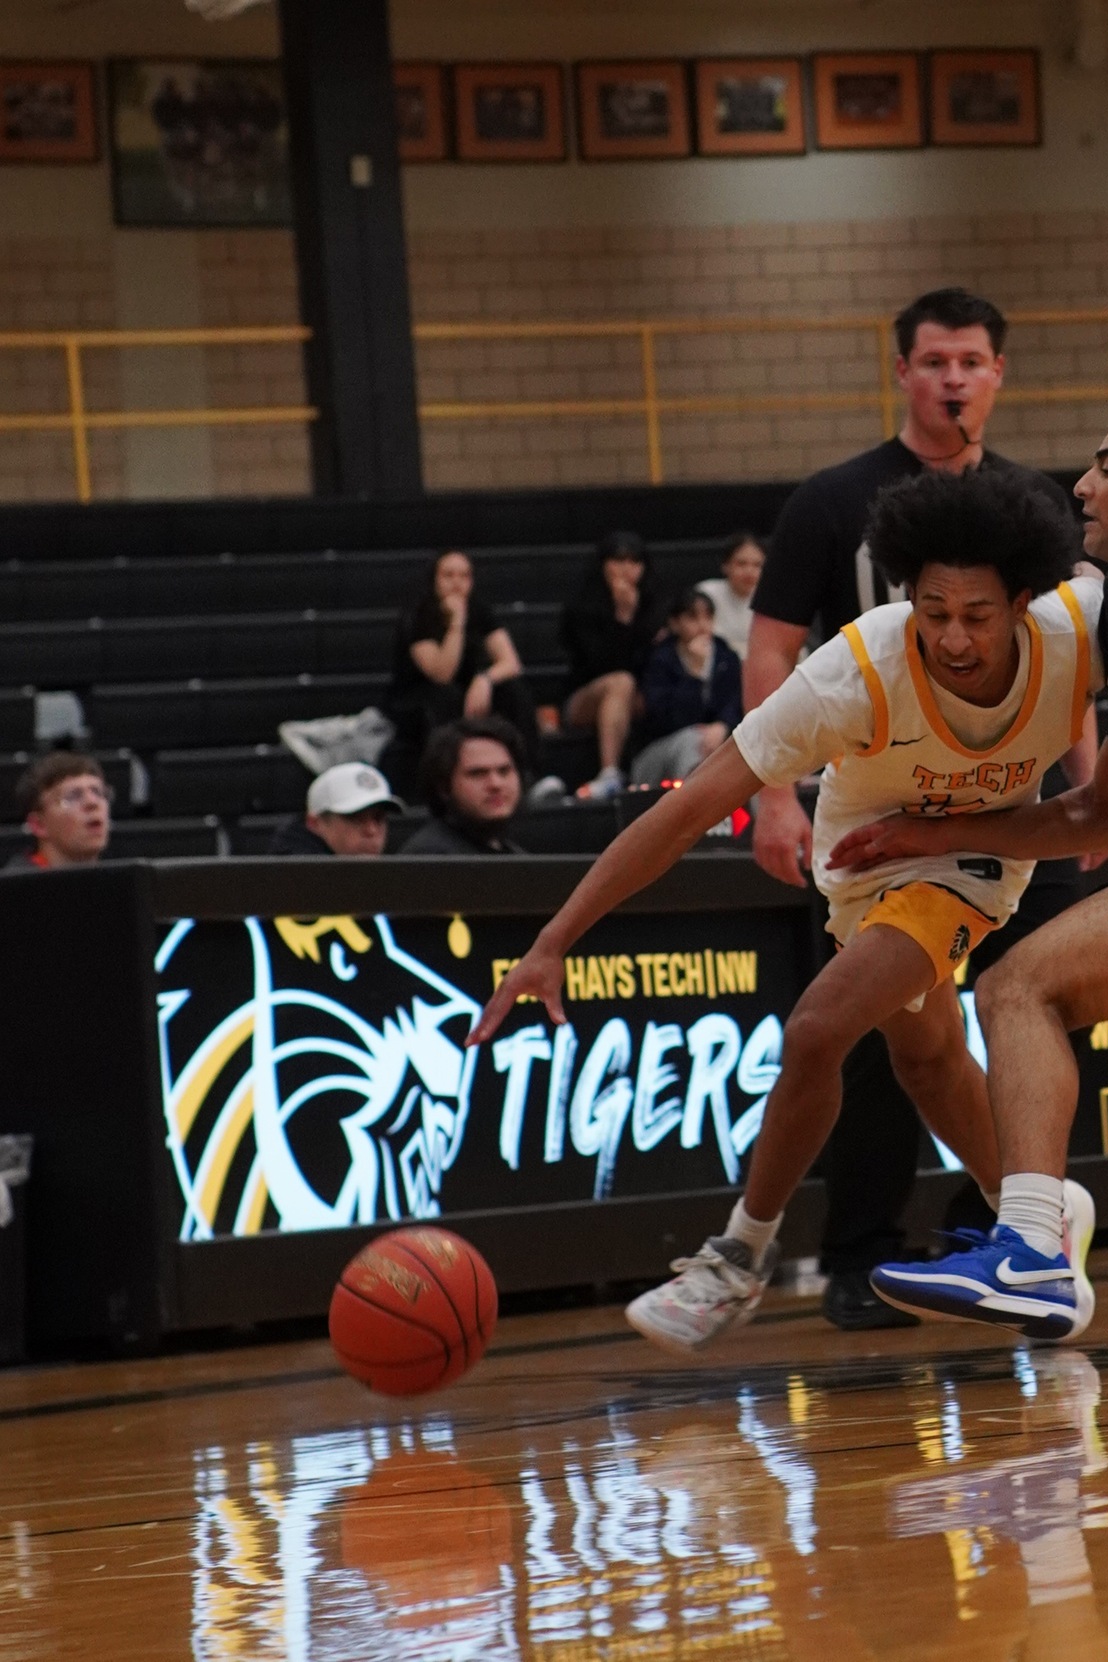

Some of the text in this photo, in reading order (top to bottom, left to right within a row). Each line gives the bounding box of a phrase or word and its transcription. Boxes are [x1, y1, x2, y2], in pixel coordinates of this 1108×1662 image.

[912, 757, 1036, 795] TECH
[565, 954, 636, 1001] HAYS
[491, 1011, 784, 1201] TIGERS
